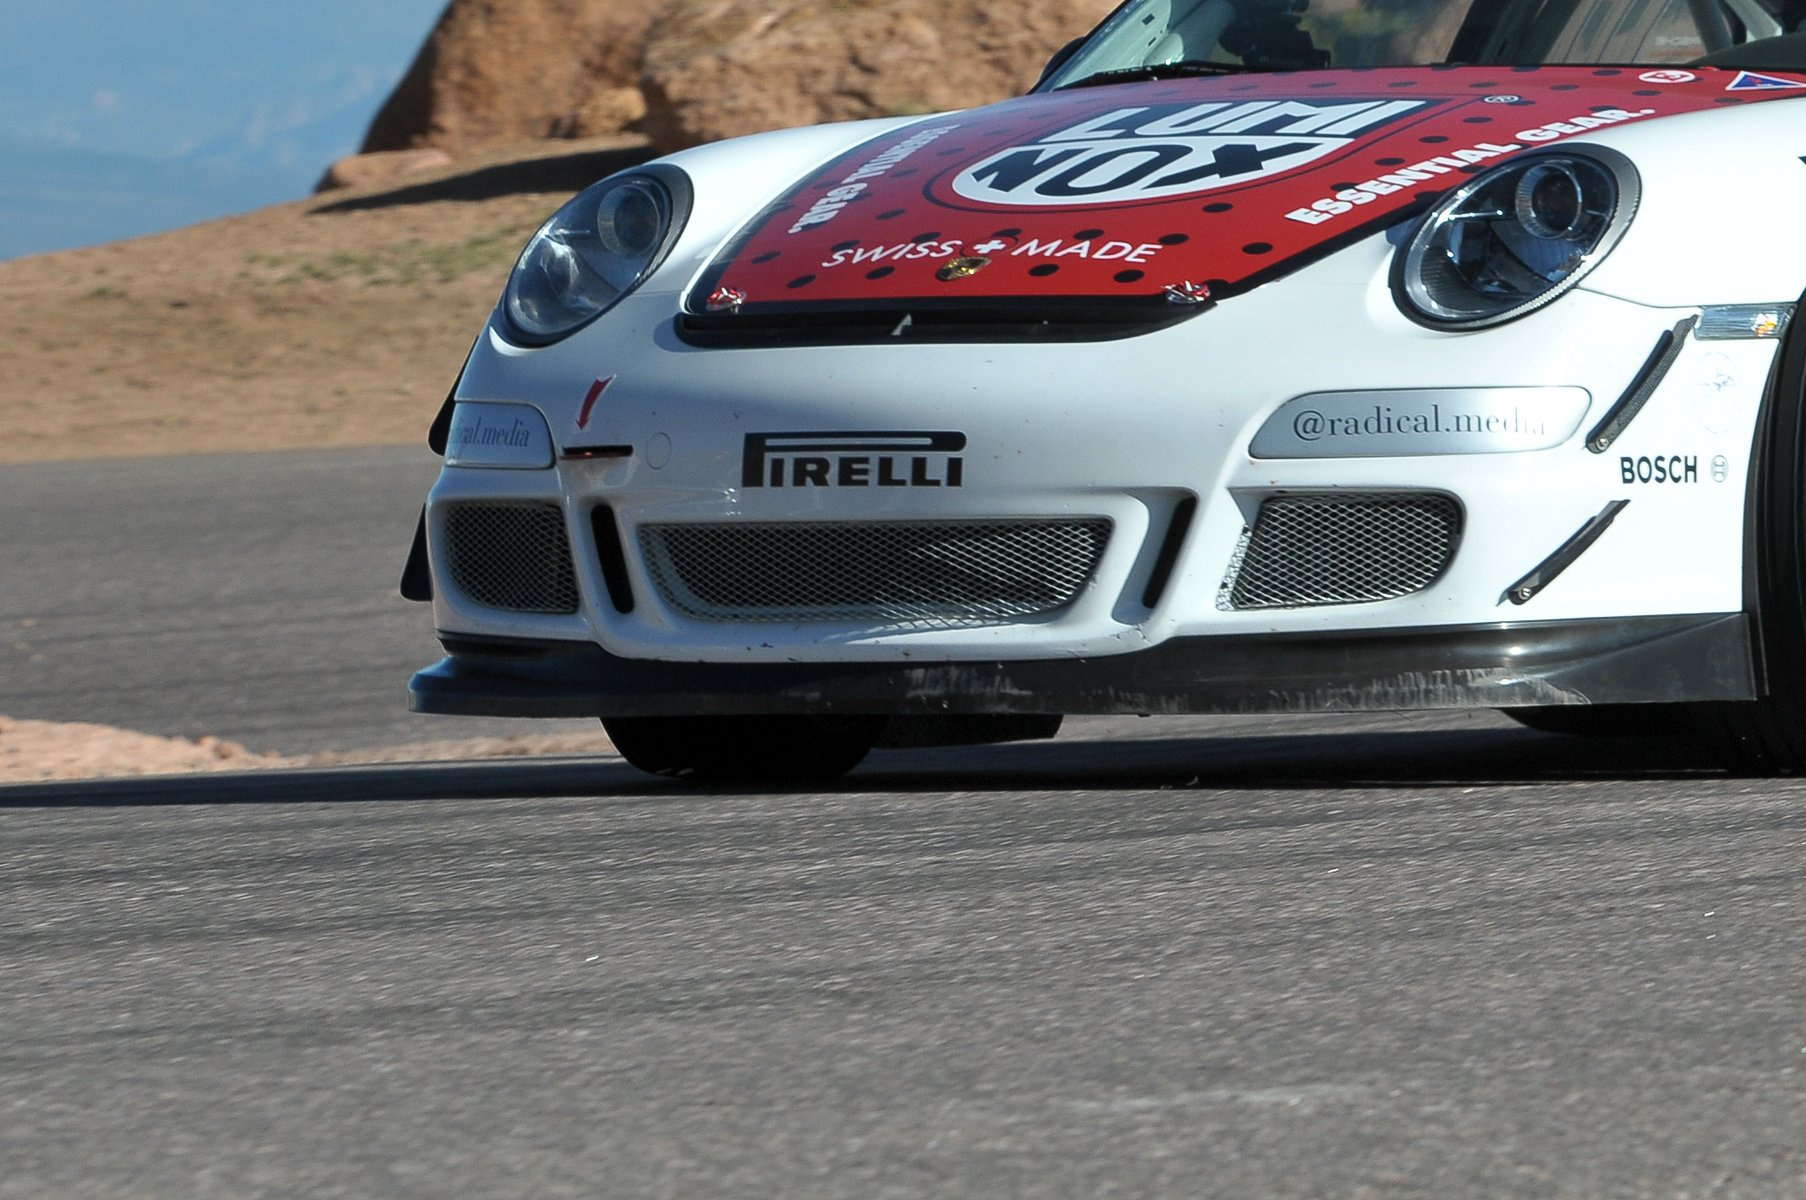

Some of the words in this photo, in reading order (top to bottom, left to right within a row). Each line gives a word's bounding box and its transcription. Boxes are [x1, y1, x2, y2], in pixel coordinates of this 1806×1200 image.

[1039, 100, 1426, 142] LUMI
[971, 142, 1316, 197] NOX
[1285, 141, 1522, 225] ESSENTIAL
[1515, 108, 1656, 142] GEAR.
[821, 239, 962, 268] SWISS
[1010, 238, 1164, 263] MADE
[1293, 404, 1546, 441] @radical.media
[741, 431, 967, 487] PIRELLI
[1620, 455, 1698, 484] BOSCH
